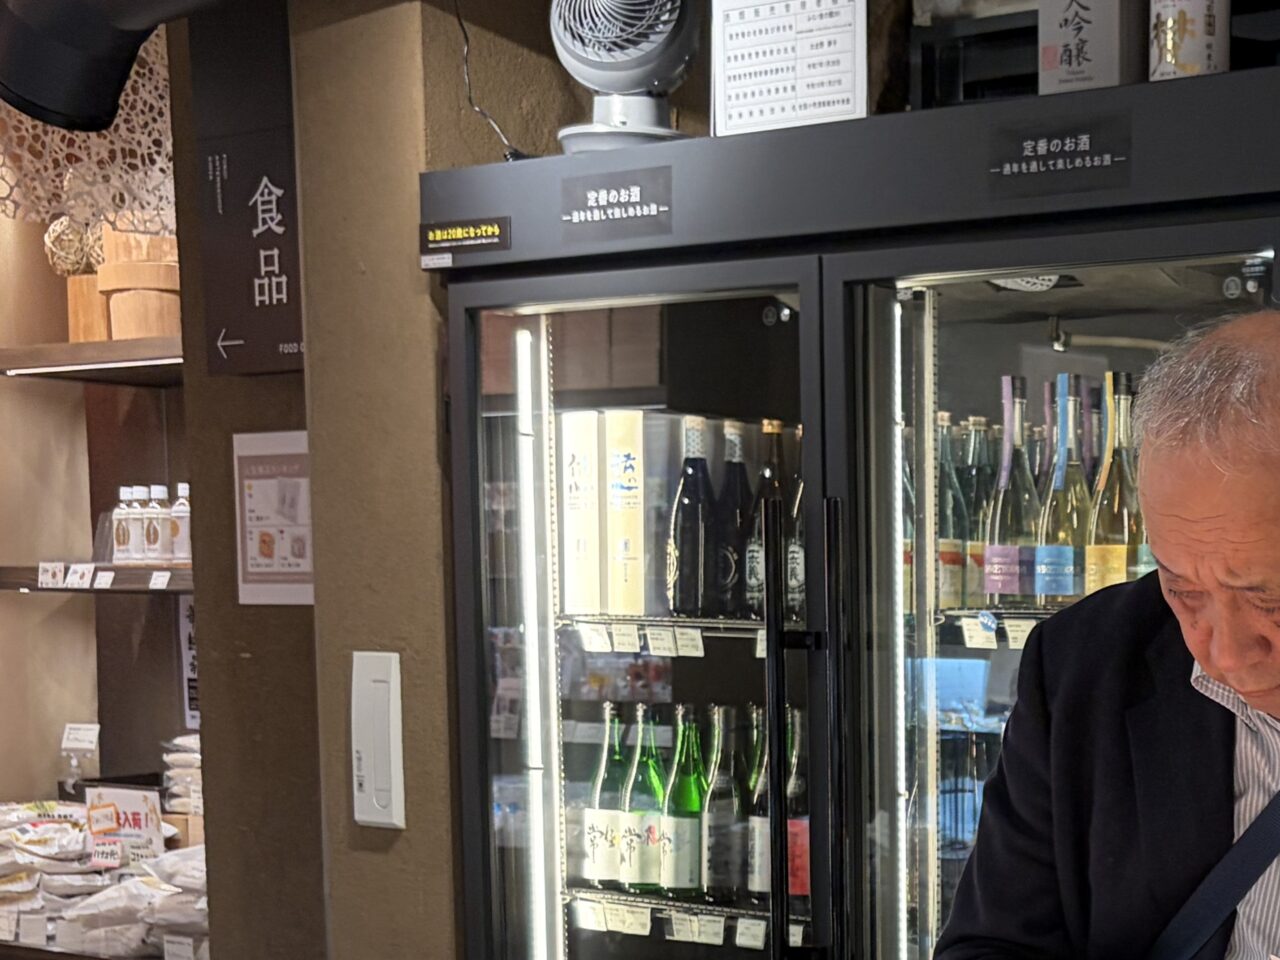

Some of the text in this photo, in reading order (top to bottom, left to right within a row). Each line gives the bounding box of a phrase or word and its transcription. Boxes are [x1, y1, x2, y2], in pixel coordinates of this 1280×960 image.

[1022, 134, 1090, 157] 定番のお酒
[1002, 153, 1112, 175] 通年を通して楽しめるお酒
[587, 185, 641, 207] 定番のお酒
[249, 176, 287, 306] 食品
